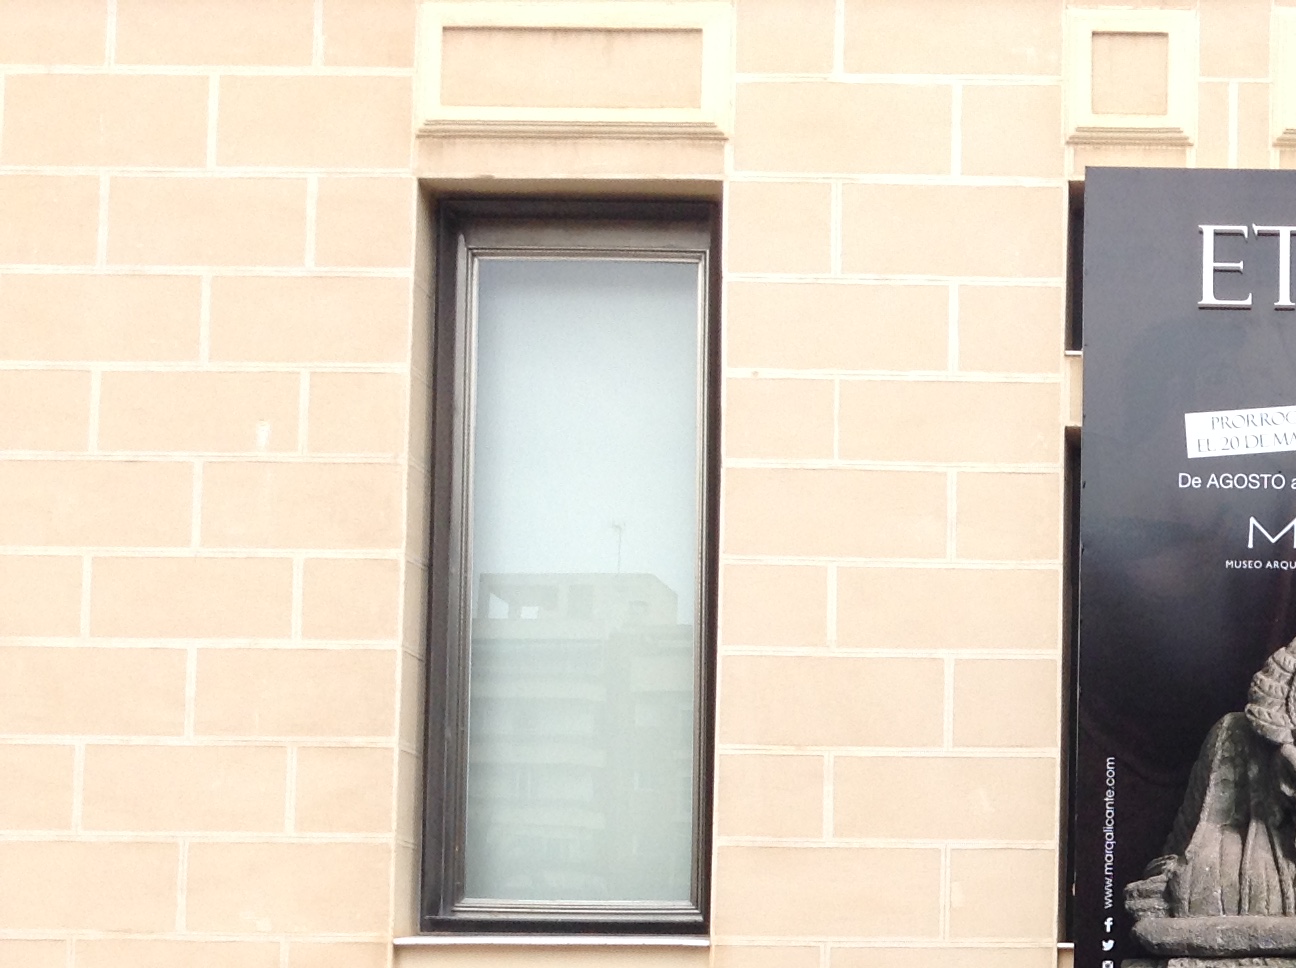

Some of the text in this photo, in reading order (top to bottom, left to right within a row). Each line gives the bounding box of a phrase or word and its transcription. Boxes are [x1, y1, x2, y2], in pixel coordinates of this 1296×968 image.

[1197, 437, 1217, 453] EL
[1221, 436, 1240, 451] 20
[1245, 433, 1270, 449] DE
[1178, 473, 1202, 489] De
[1206, 473, 1286, 490] AGOSTO
[1225, 560, 1263, 570] MUSEO
[1103, 757, 1116, 908] www.marqalicante.com
